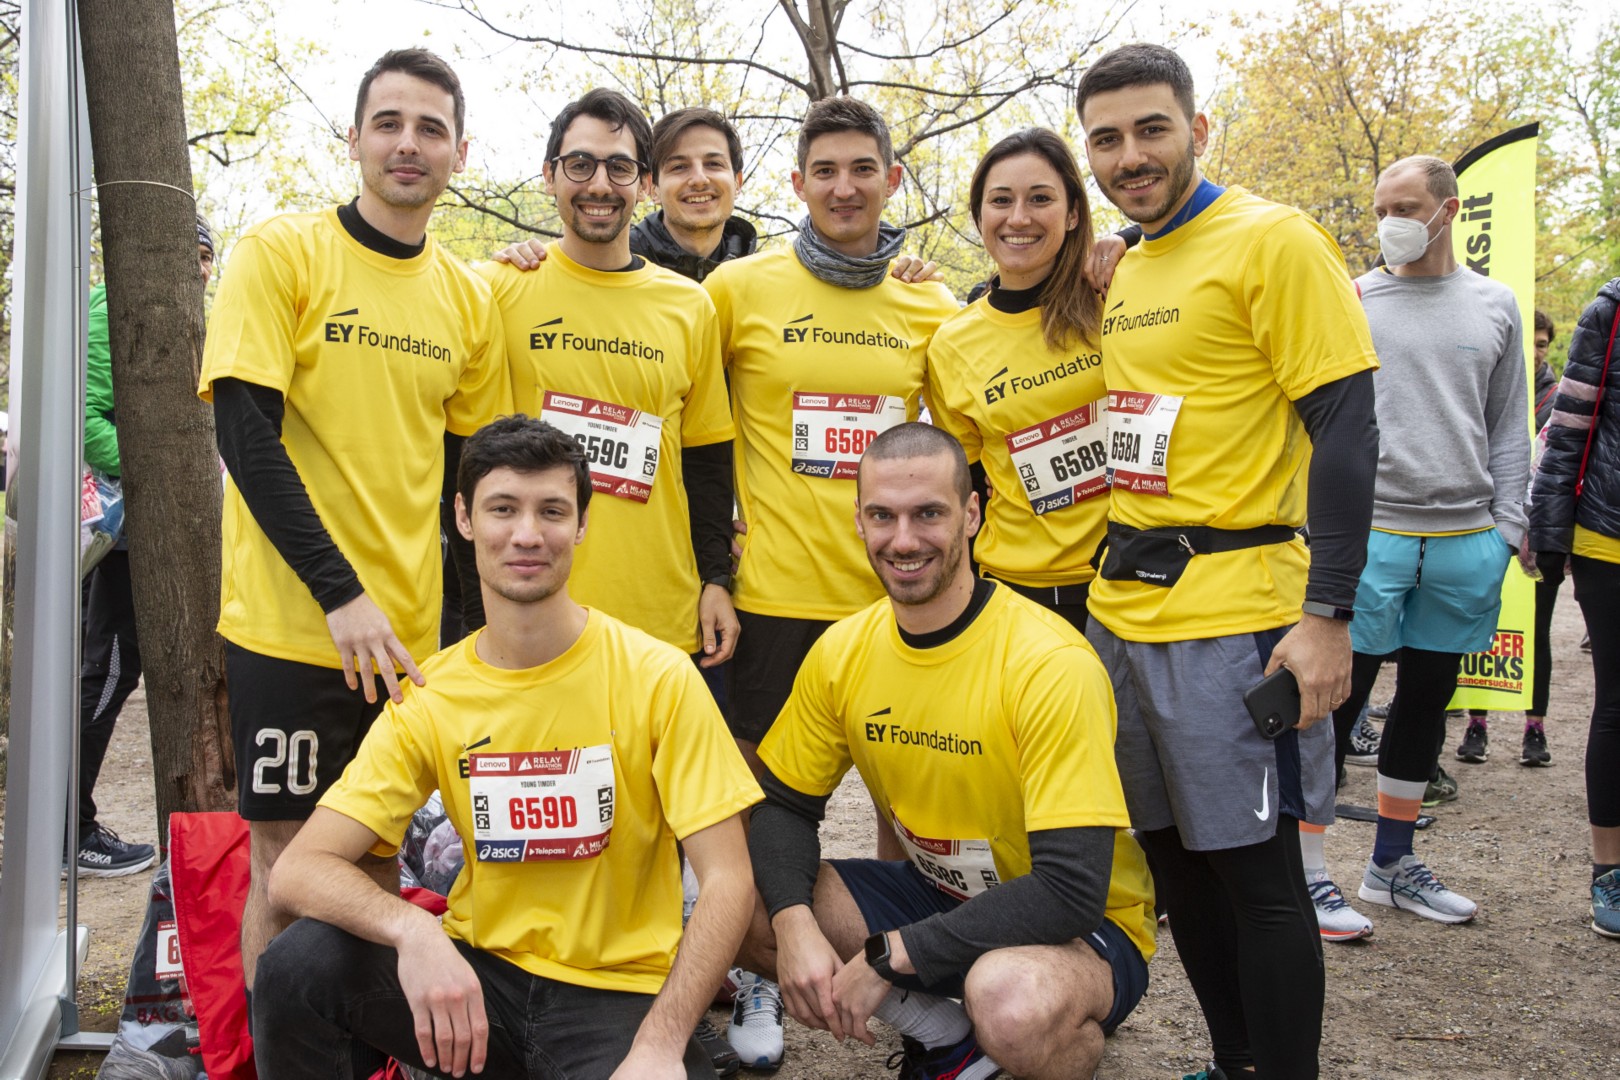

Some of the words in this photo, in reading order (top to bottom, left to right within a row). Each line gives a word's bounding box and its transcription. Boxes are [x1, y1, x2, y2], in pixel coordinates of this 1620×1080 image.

[1103, 316, 1116, 336] EY
[1116, 306, 1180, 333] Foundation
[325, 323, 354, 343] EY
[358, 326, 451, 363] Foundation
[530, 333, 558, 350] EY
[562, 333, 664, 364] Foundation
[783, 328, 808, 343] EY
[813, 328, 909, 350] Foundation
[984, 381, 1006, 406] EY
[1010, 351, 1103, 394] Foundatio
[553, 398, 580, 409] Lenovo
[602, 405, 626, 416] RELAY
[801, 397, 827, 405] Lenovo
[1128, 396, 1146, 405] RELAY
[587, 422, 602, 430] YOUNG
[1060, 412, 1084, 425] RELAY
[1014, 432, 1040, 445] Lenovo
[1111, 431, 1142, 464] 658A
[1050, 440, 1107, 482] 658B
[1142, 480, 1166, 488] MILANO
[1458, 654, 1524, 680] UCKS
[865, 722, 886, 743] EY
[890, 725, 982, 755] Foundation
[252, 728, 318, 795] 20
[458, 758, 470, 779] E
[480, 760, 506, 768] Lenovo
[508, 796, 578, 830] 659D
[78, 849, 112, 864] HOKA
[535, 848, 566, 856] Telepass
[915, 854, 968, 891] 658C
